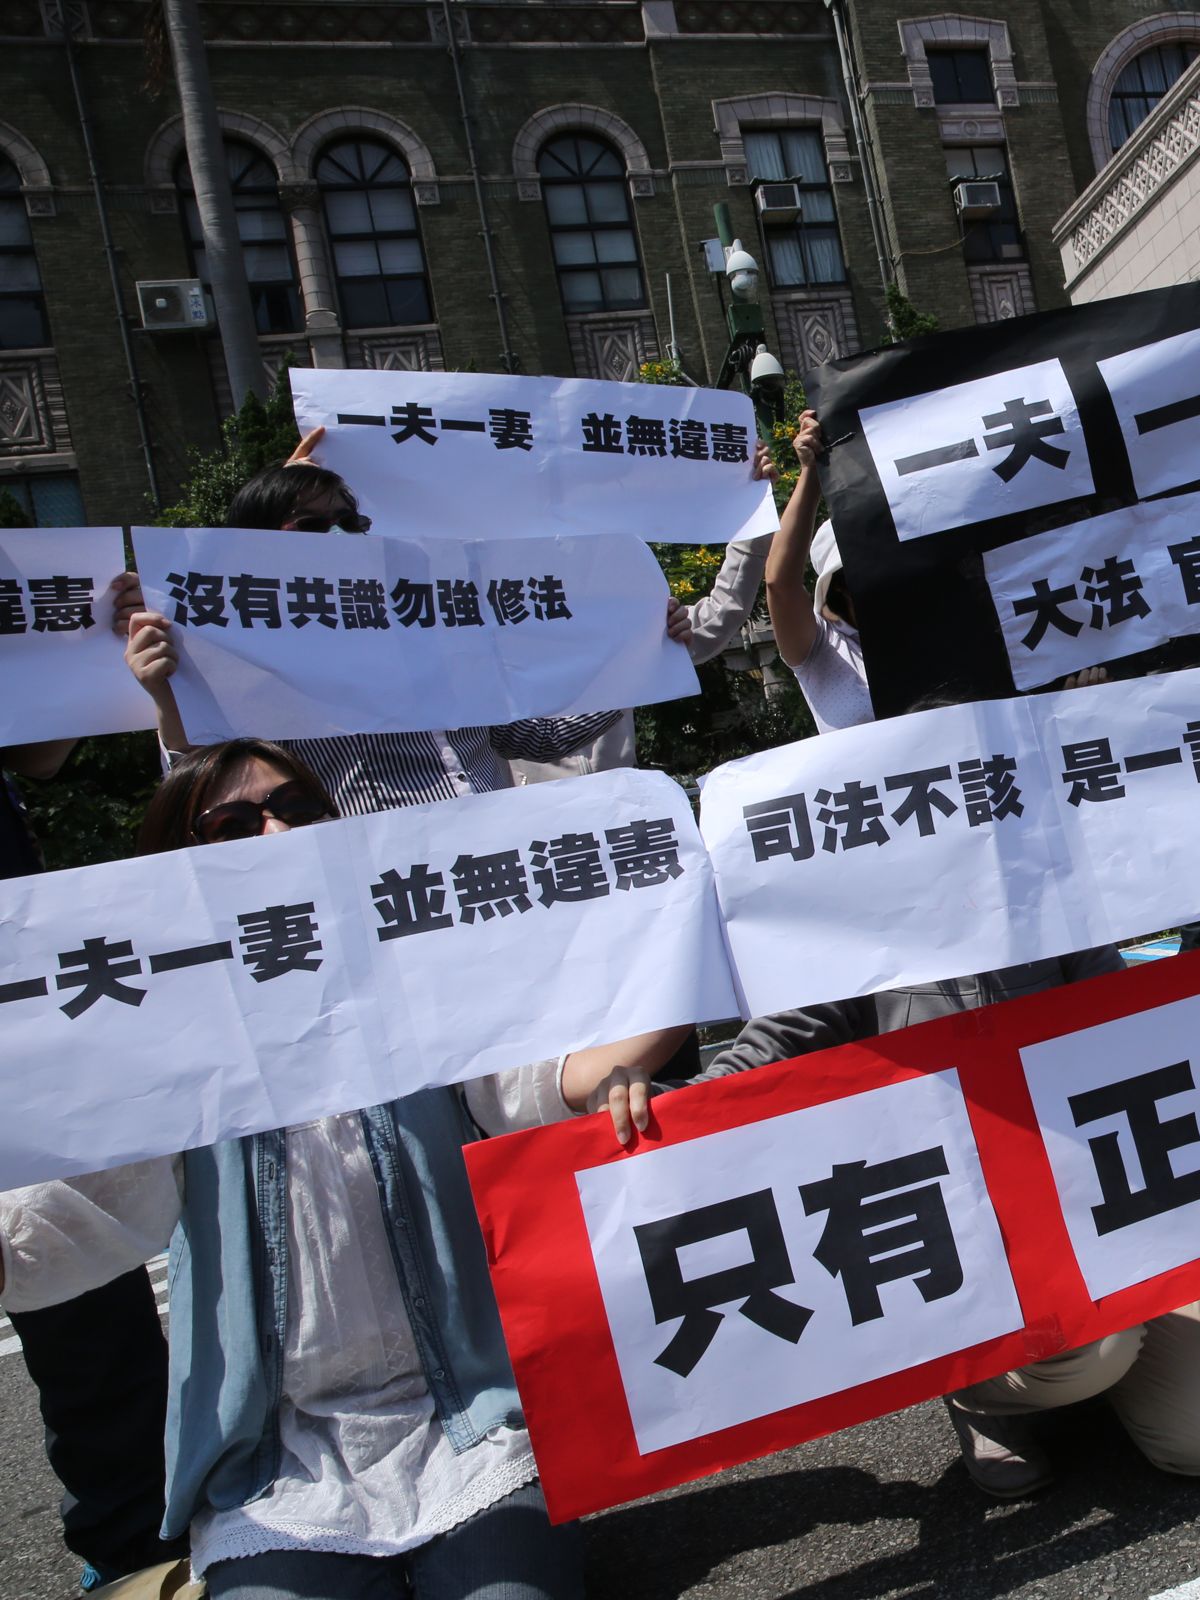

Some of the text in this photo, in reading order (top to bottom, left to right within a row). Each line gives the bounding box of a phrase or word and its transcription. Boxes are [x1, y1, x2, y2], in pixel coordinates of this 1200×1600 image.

[338, 403, 749, 462] 一夫一妻 並無違憲
[894, 397, 1071, 483] 一夫
[166, 572, 572, 629] 沒有共識勿強修法
[744, 755, 1025, 861] 司法不該
[371, 818, 685, 941] 並無違憲
[633, 1146, 963, 1378] 只有
